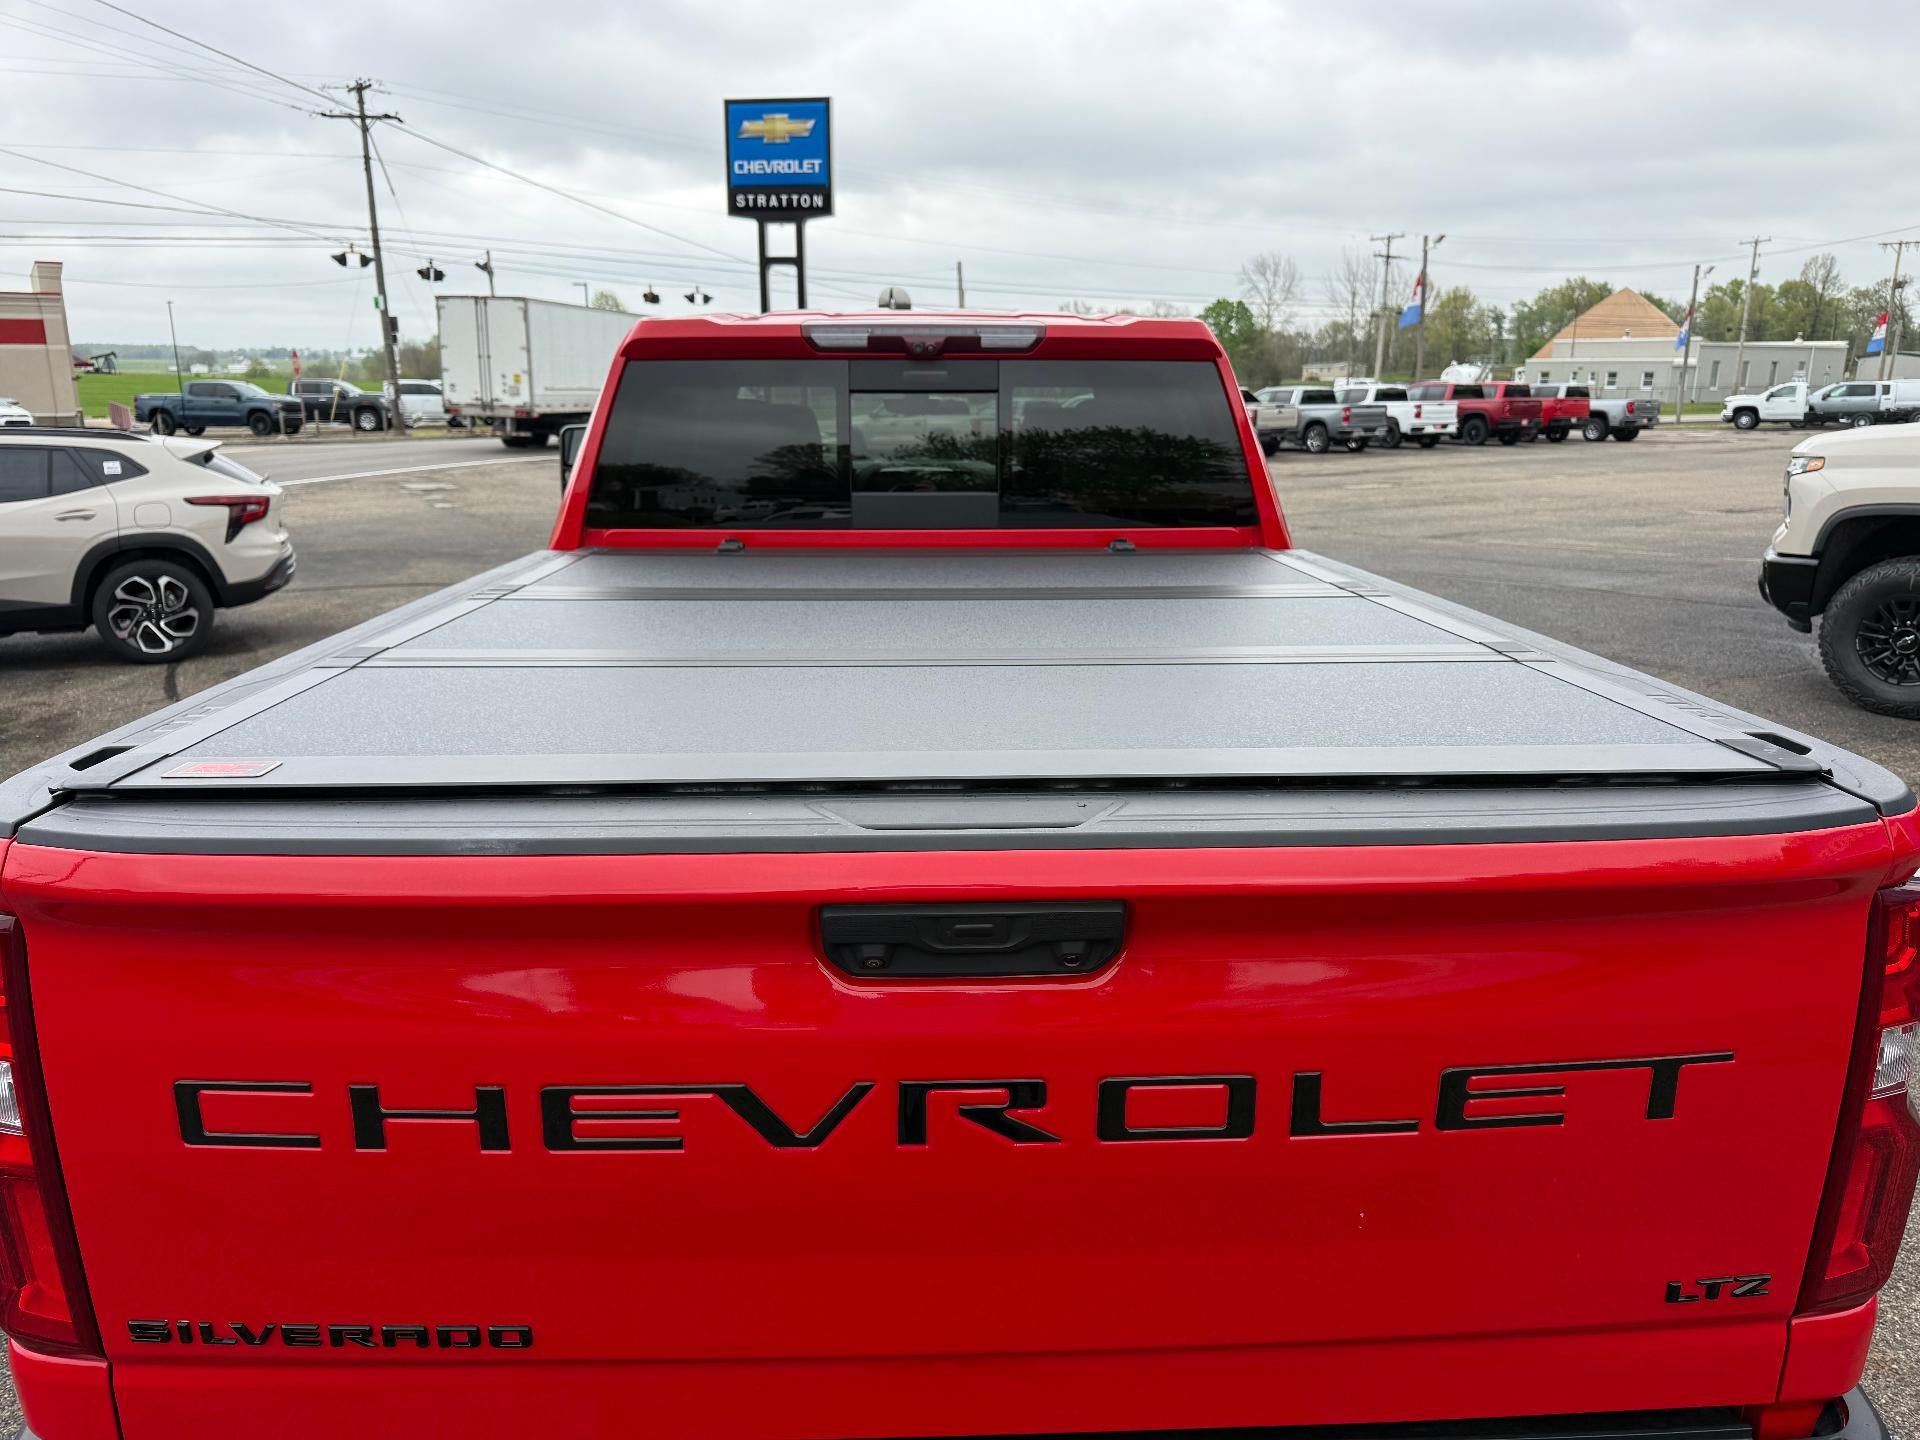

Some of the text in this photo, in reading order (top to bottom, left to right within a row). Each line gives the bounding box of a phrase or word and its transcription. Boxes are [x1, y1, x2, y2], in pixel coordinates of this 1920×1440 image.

[733, 158, 822, 175] CHEVROLET
[735, 193, 823, 208] STRATTON
[173, 1051, 1735, 1153] CHEVROLET
[1665, 1274, 1771, 1304] LTZ
[127, 1319, 533, 1349] SILVERADO
